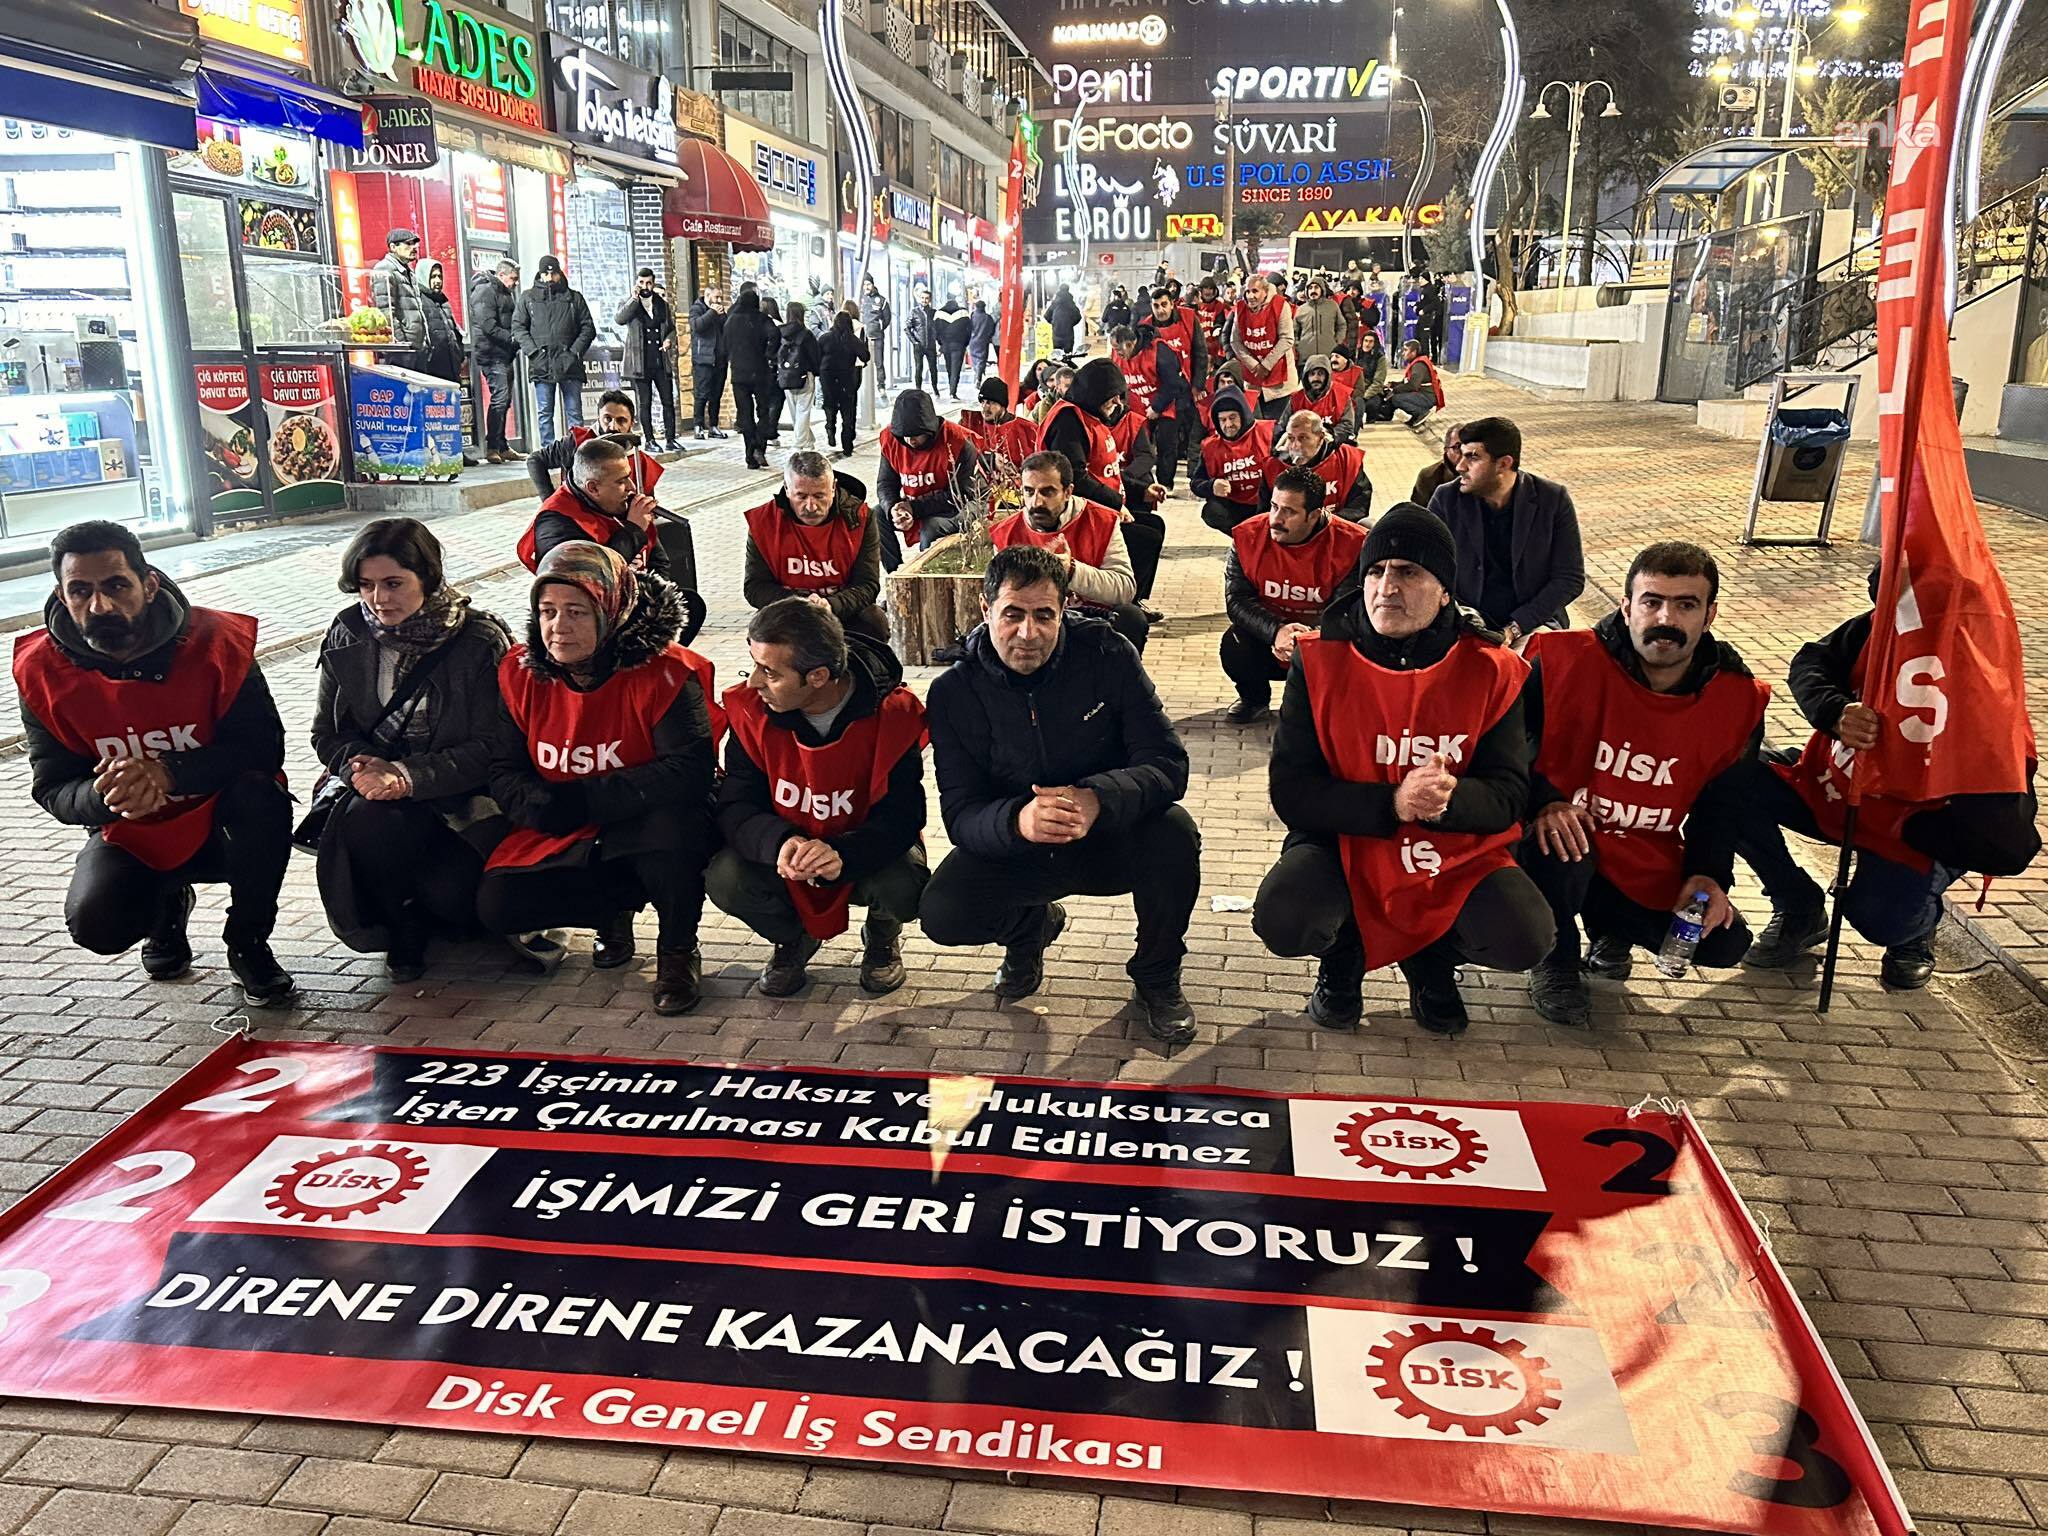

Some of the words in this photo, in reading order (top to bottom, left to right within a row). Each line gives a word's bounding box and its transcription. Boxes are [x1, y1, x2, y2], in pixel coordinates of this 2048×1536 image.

[391, 0, 536, 98] LADES
[1053, 22, 1139, 44] KORKMAZ
[418, 66, 457, 101] HATAY
[460, 81, 498, 114] SOSLU
[499, 91, 539, 126] DÖNER
[560, 48, 624, 143] Tolga
[1053, 61, 1153, 105] Penti
[1211, 60, 1394, 98] SPORTIVE
[378, 107, 431, 128] LADES
[1054, 116, 1193, 152] DeFacto
[352, 138, 431, 166] DÖNER
[1213, 116, 1338, 155] SÜVARİ
[1054, 163, 1097, 196] LB
[1185, 163, 1225, 188] U.S
[1240, 162, 1312, 187] POLO
[1241, 188, 1291, 203] SINCE
[1297, 186, 1333, 201] 1890
[682, 218, 703, 233] Cafe
[704, 219, 742, 236] Restaurant
[198, 369, 212, 387] ÇİĞ
[213, 369, 245, 383] KÖFTECİ
[200, 386, 226, 399] DAVUT
[228, 386, 248, 398] USTA
[270, 368, 285, 388] ÇİĞ
[286, 368, 320, 384] KÖFTECİ
[273, 387, 300, 402] DAVUT
[302, 387, 321, 401] USTA
[356, 403, 392, 419] PINAR
[393, 404, 410, 419] SU
[369, 388, 395, 404] GAP
[425, 404, 446, 419] PINAR
[432, 389, 448, 404] GAP
[386, 424, 418, 433] TİCARET
[1224, 454, 1256, 472] DİSK
[787, 554, 840, 578] DİSK
[1264, 579, 1324, 603] DİSK
[95, 723, 202, 760] DİSK
[536, 739, 625, 775] DİSK
[1375, 728, 1469, 767] DİSK
[1593, 741, 1680, 787] DİSK
[774, 777, 855, 822] DİSK
[1400, 836, 1443, 878] İŞ
[181, 1057, 308, 1113] 2
[405, 1062, 509, 1087] 223
[518, 1061, 676, 1099] İşçinin
[891, 1089, 937, 1108] ve
[964, 1087, 1272, 1131] Hukuksuzca
[394, 1090, 519, 1125] İşten
[536, 1101, 822, 1139] Çıkarılması
[839, 1115, 997, 1148] Kabul
[1011, 1125, 1252, 1166] Edilemez
[1368, 1130, 1455, 1151] DİSK
[1583, 1128, 1682, 1195] 2
[43, 1150, 196, 1224] 2
[302, 1168, 394, 1191] DİSK
[511, 1169, 782, 1223] İŞİMİZİ
[801, 1191, 977, 1235] GERİ
[1001, 1197, 1430, 1271] İSTİYORUZ
[145, 1266, 417, 1322] DİRENE
[418, 1282, 693, 1344] DİRENE
[704, 1307, 1260, 1390] KAZANACAĞIZ
[1408, 1357, 1519, 1391] DİSK
[427, 1374, 564, 1420] Disk
[582, 1387, 767, 1437] Genel
[783, 1394, 838, 1452] İş
[856, 1408, 1163, 1471] Sendikası
